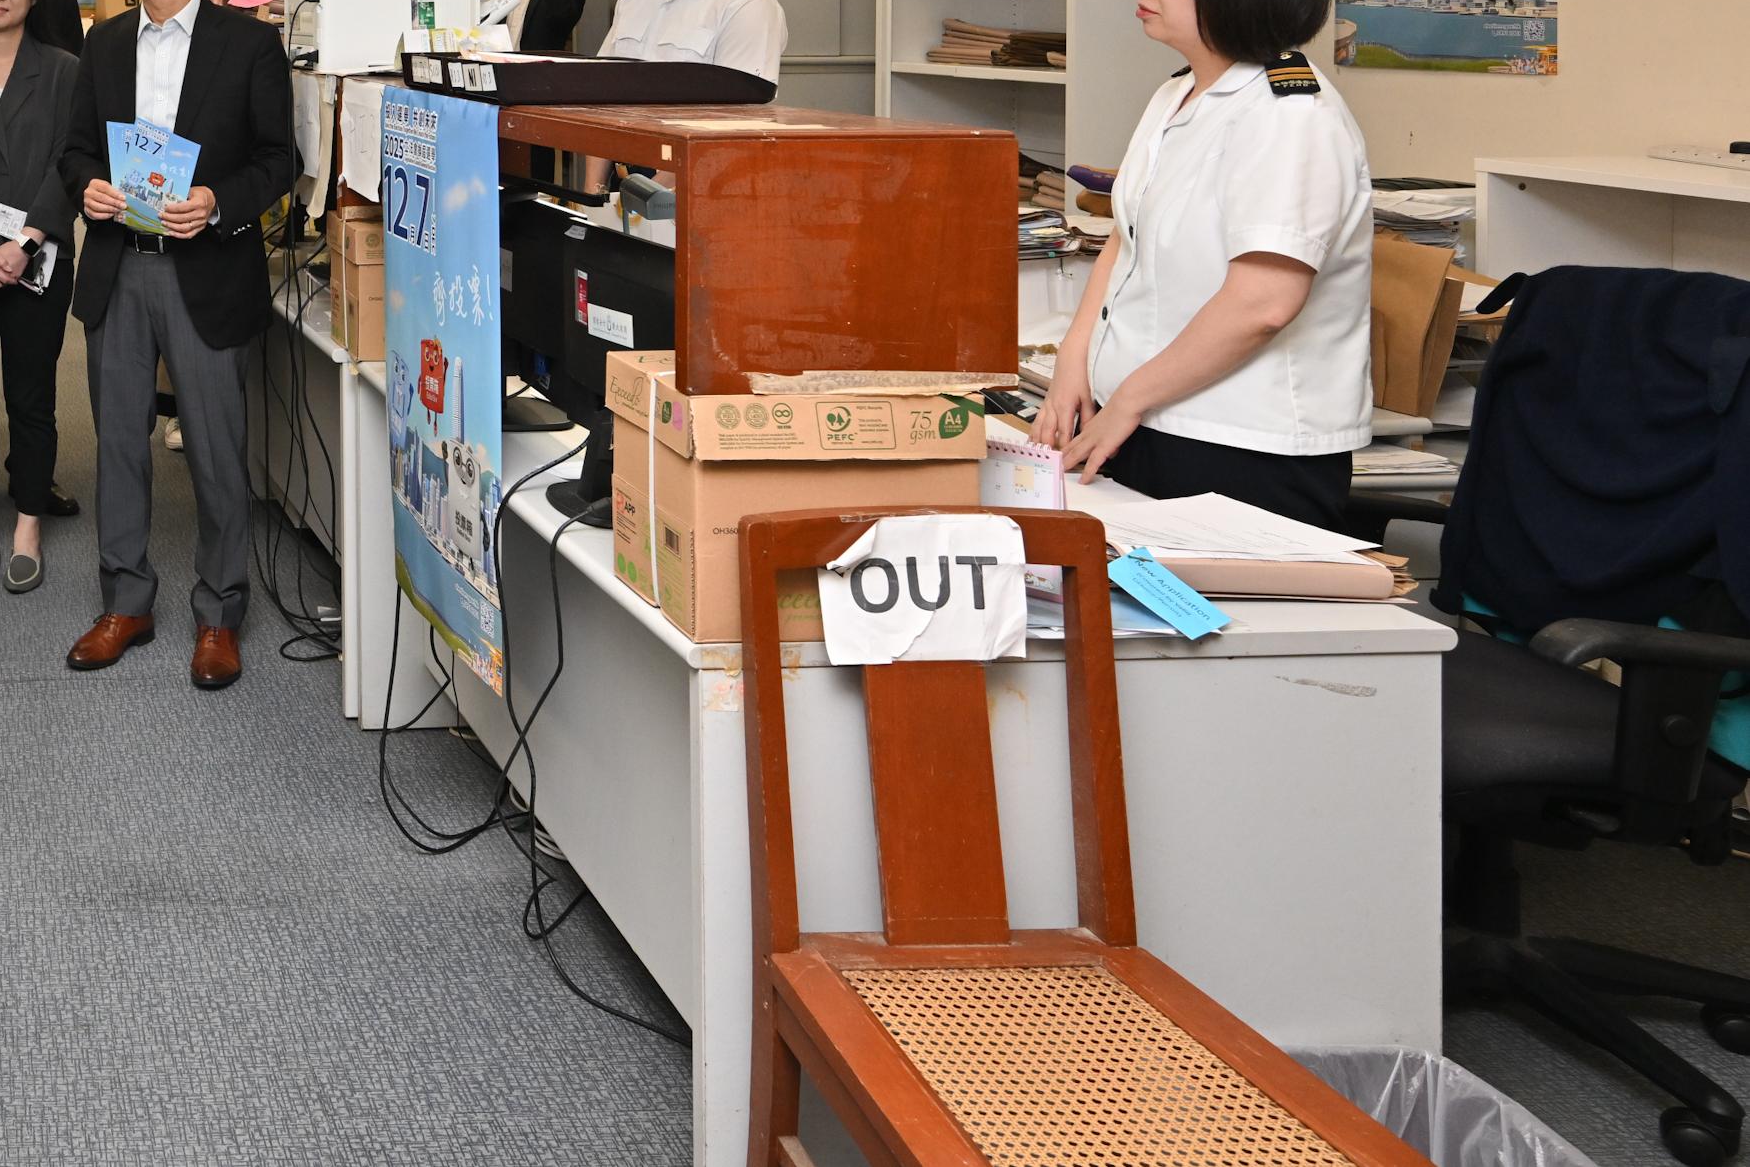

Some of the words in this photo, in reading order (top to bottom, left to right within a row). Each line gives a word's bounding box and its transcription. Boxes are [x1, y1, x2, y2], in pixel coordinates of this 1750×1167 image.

[910, 411, 932, 429] 75
[945, 412, 962, 425] A4
[910, 429, 937, 444] gsm
[850, 555, 998, 614] OUT
[1135, 560, 1155, 577] New
[1158, 579, 1210, 620] Application
